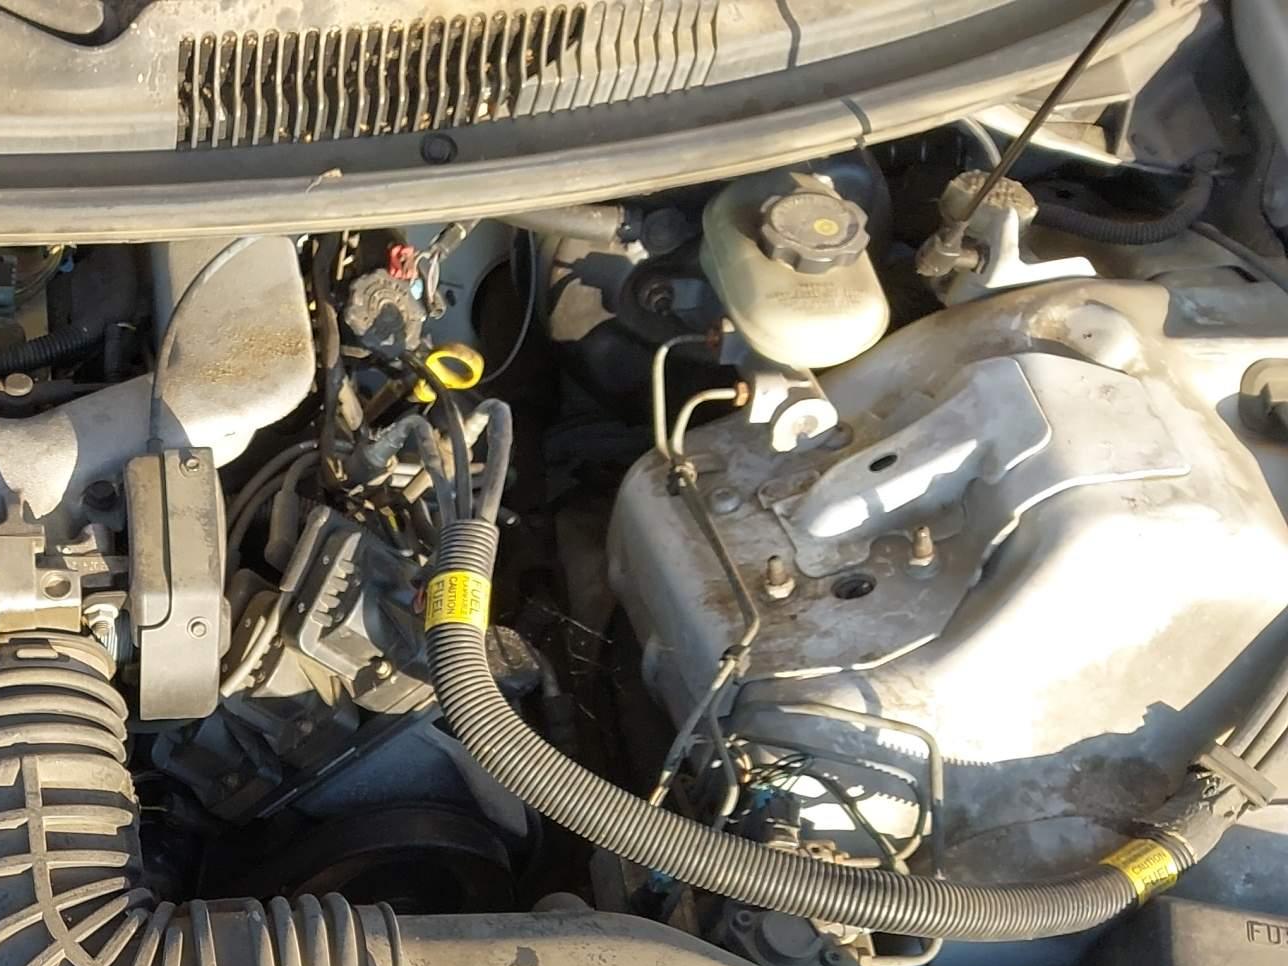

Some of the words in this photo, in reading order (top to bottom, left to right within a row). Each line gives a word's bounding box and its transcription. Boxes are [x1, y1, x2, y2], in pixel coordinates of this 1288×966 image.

[432, 579, 444, 614] FUEL
[446, 577, 458, 614] CAUTION
[469, 578, 482, 615] FUEL
[1131, 851, 1167, 875] CAUTION
